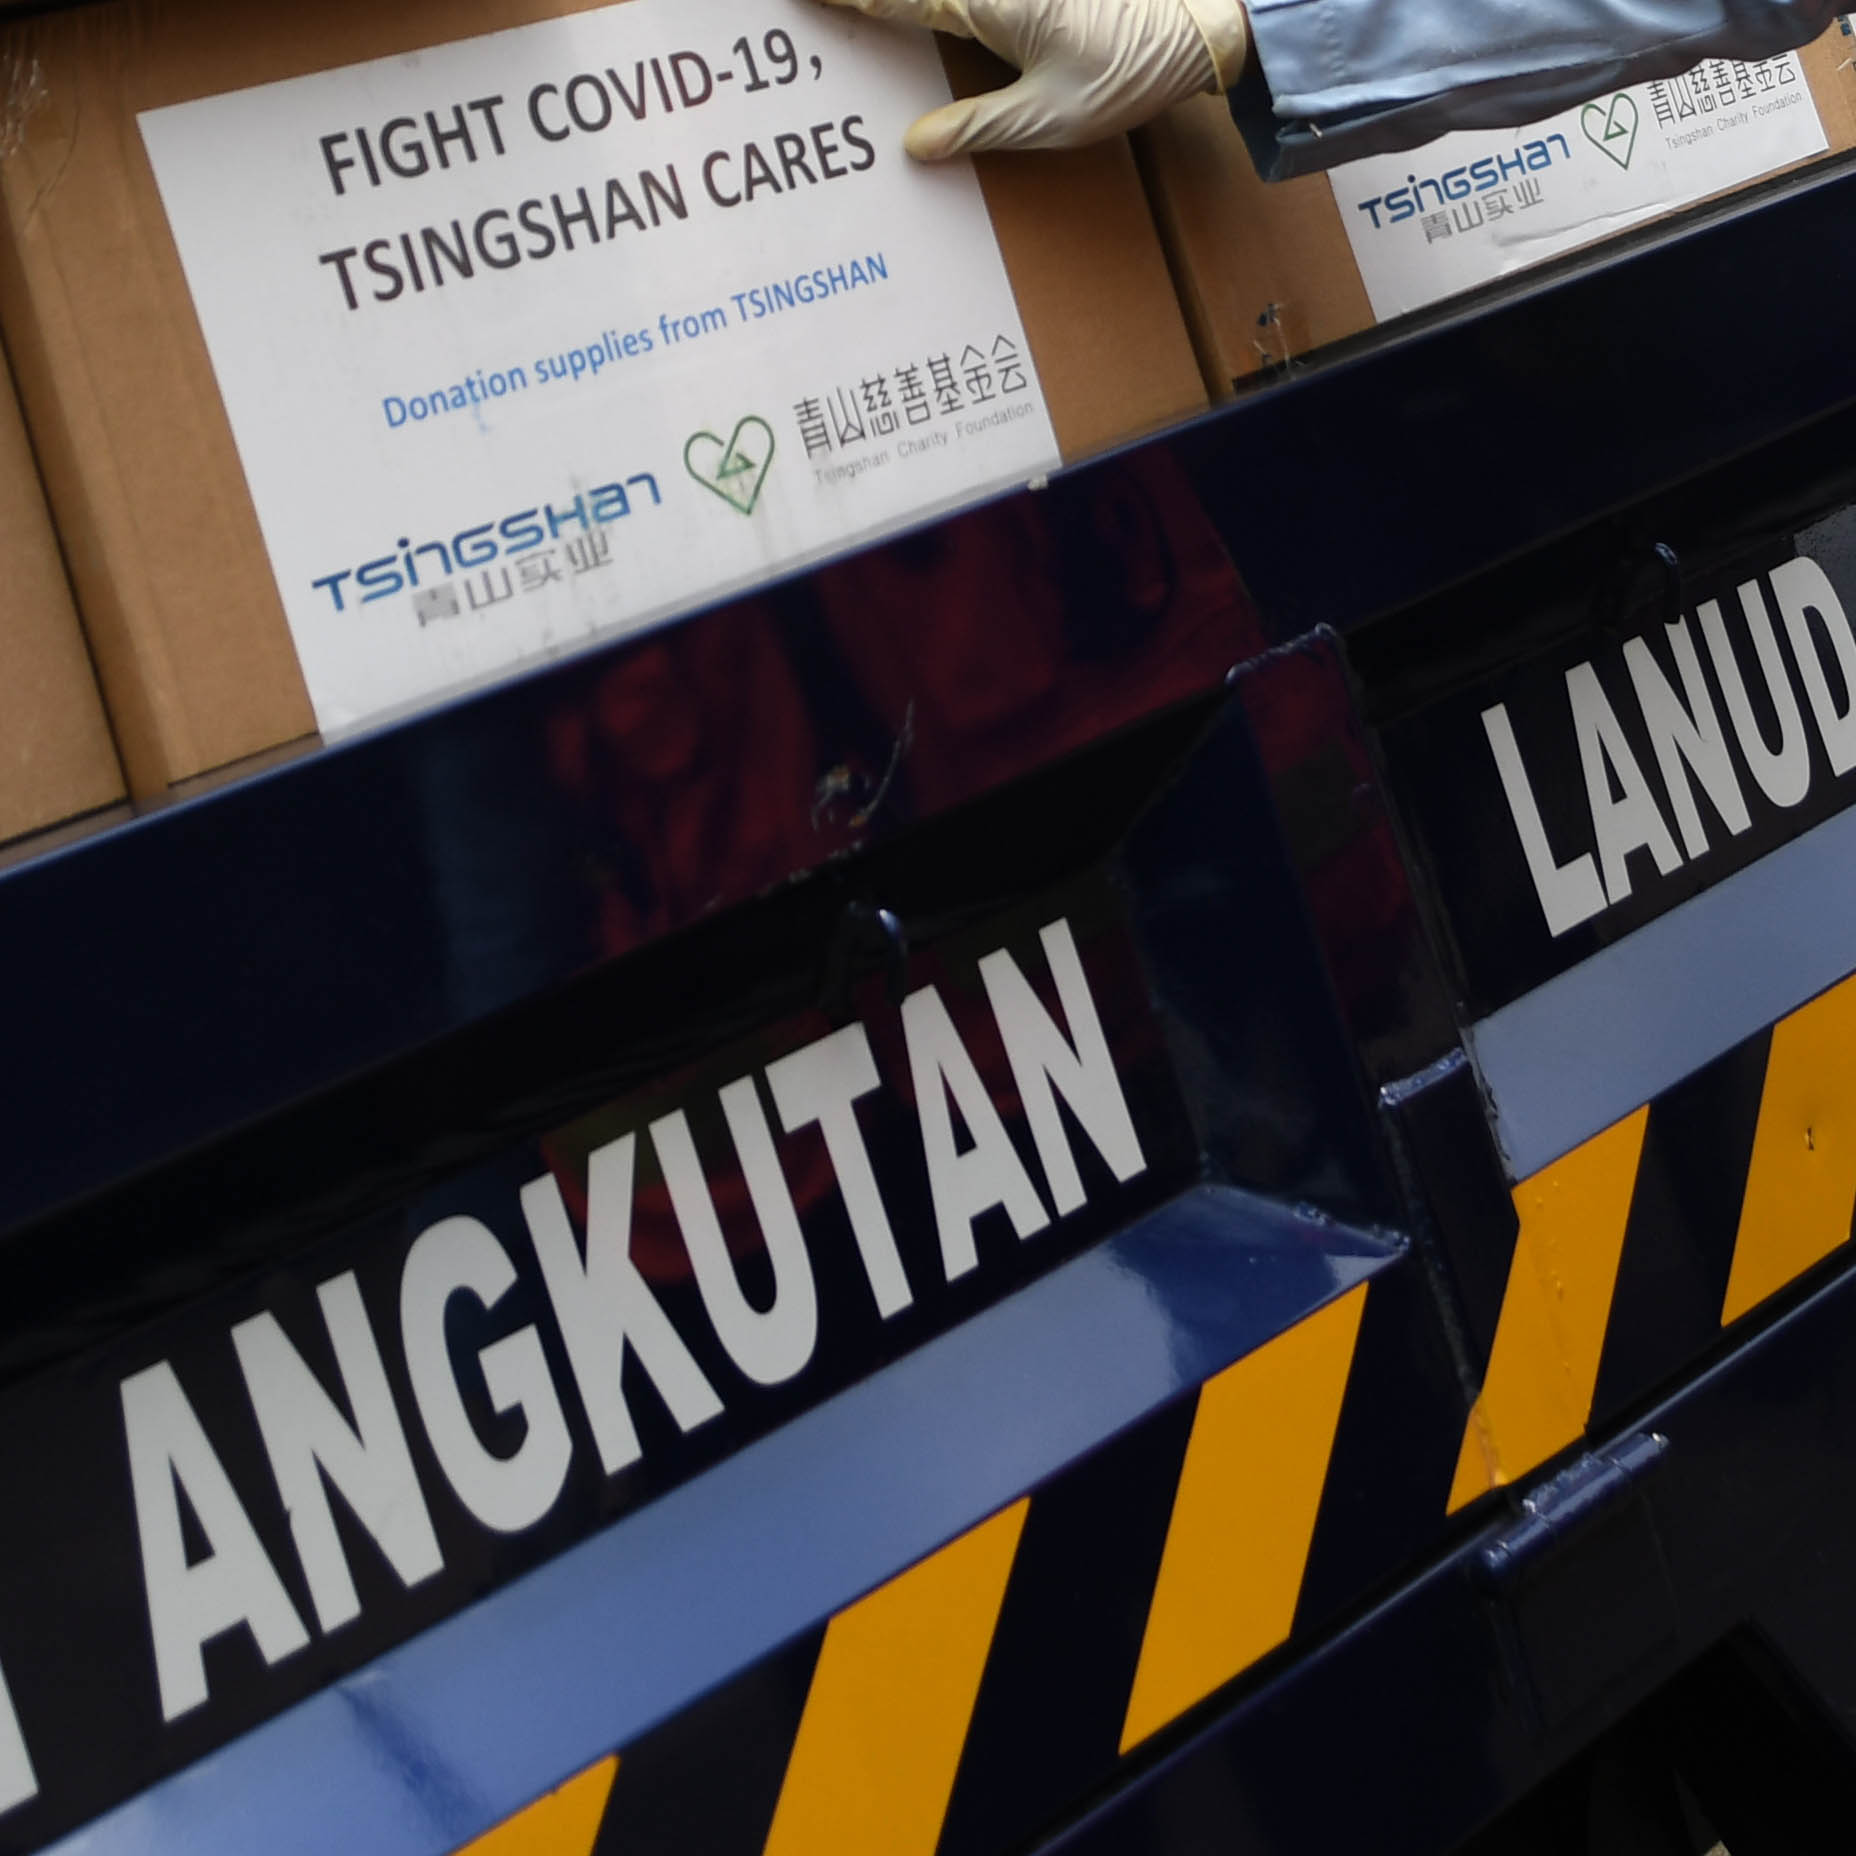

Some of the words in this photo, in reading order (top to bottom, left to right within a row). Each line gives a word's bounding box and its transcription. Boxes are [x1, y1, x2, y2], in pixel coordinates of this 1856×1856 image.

[320, 96, 509, 196] FIGHT
[524, 27, 828, 145] COVID-19,
[1716, 112, 1750, 136] Charity
[1752, 90, 1804, 121] Foundation
[316, 161, 692, 312] TSINGSHAN
[699, 114, 881, 214] CARES
[382, 362, 530, 431] Donation
[533, 322, 657, 393] supplies
[656, 294, 729, 354] from
[730, 251, 892, 327] TSINGSHAN
[792, 333, 1033, 461] 青山慈善基金会
[812, 442, 894, 489] Tsingshan
[895, 424, 951, 462] Charity
[953, 399, 1036, 444] Foundation
[119, 918, 1150, 1725] ANGKUTAN
